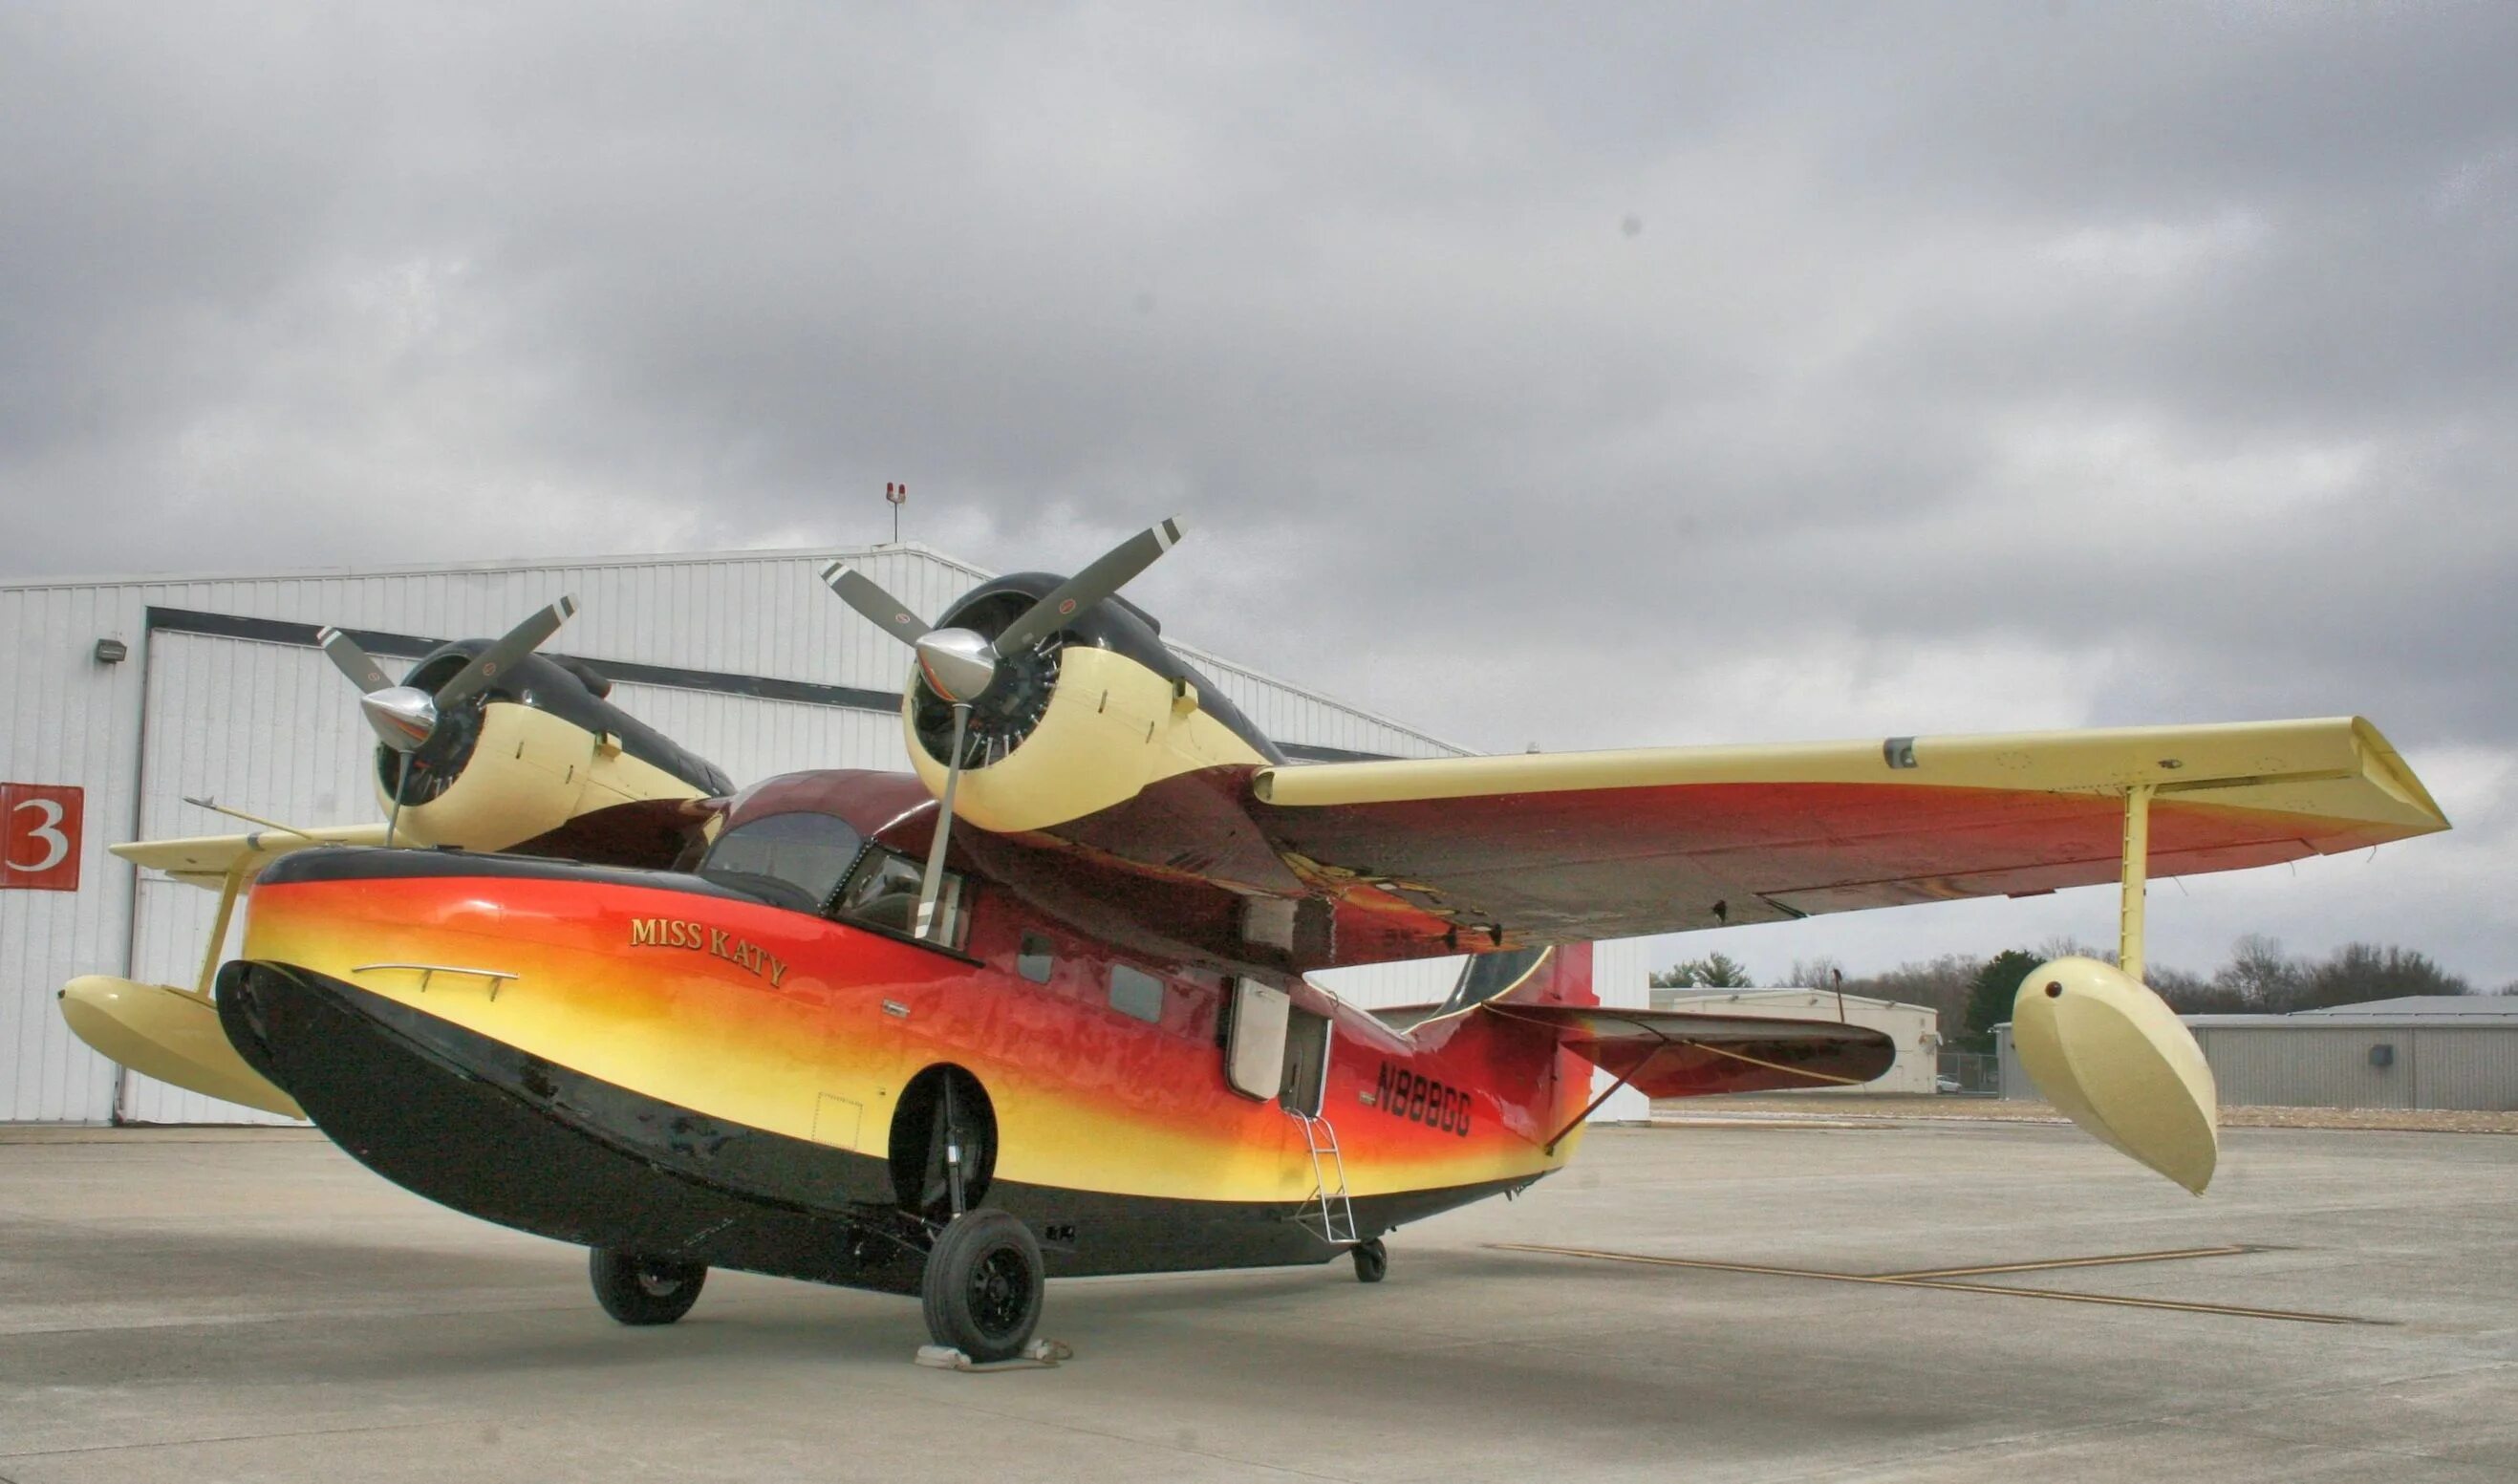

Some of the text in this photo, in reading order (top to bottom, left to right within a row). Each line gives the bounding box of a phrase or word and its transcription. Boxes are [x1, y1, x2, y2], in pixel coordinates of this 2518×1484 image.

[5, 798, 69, 871] 3
[631, 918, 787, 988] MISS KATY
